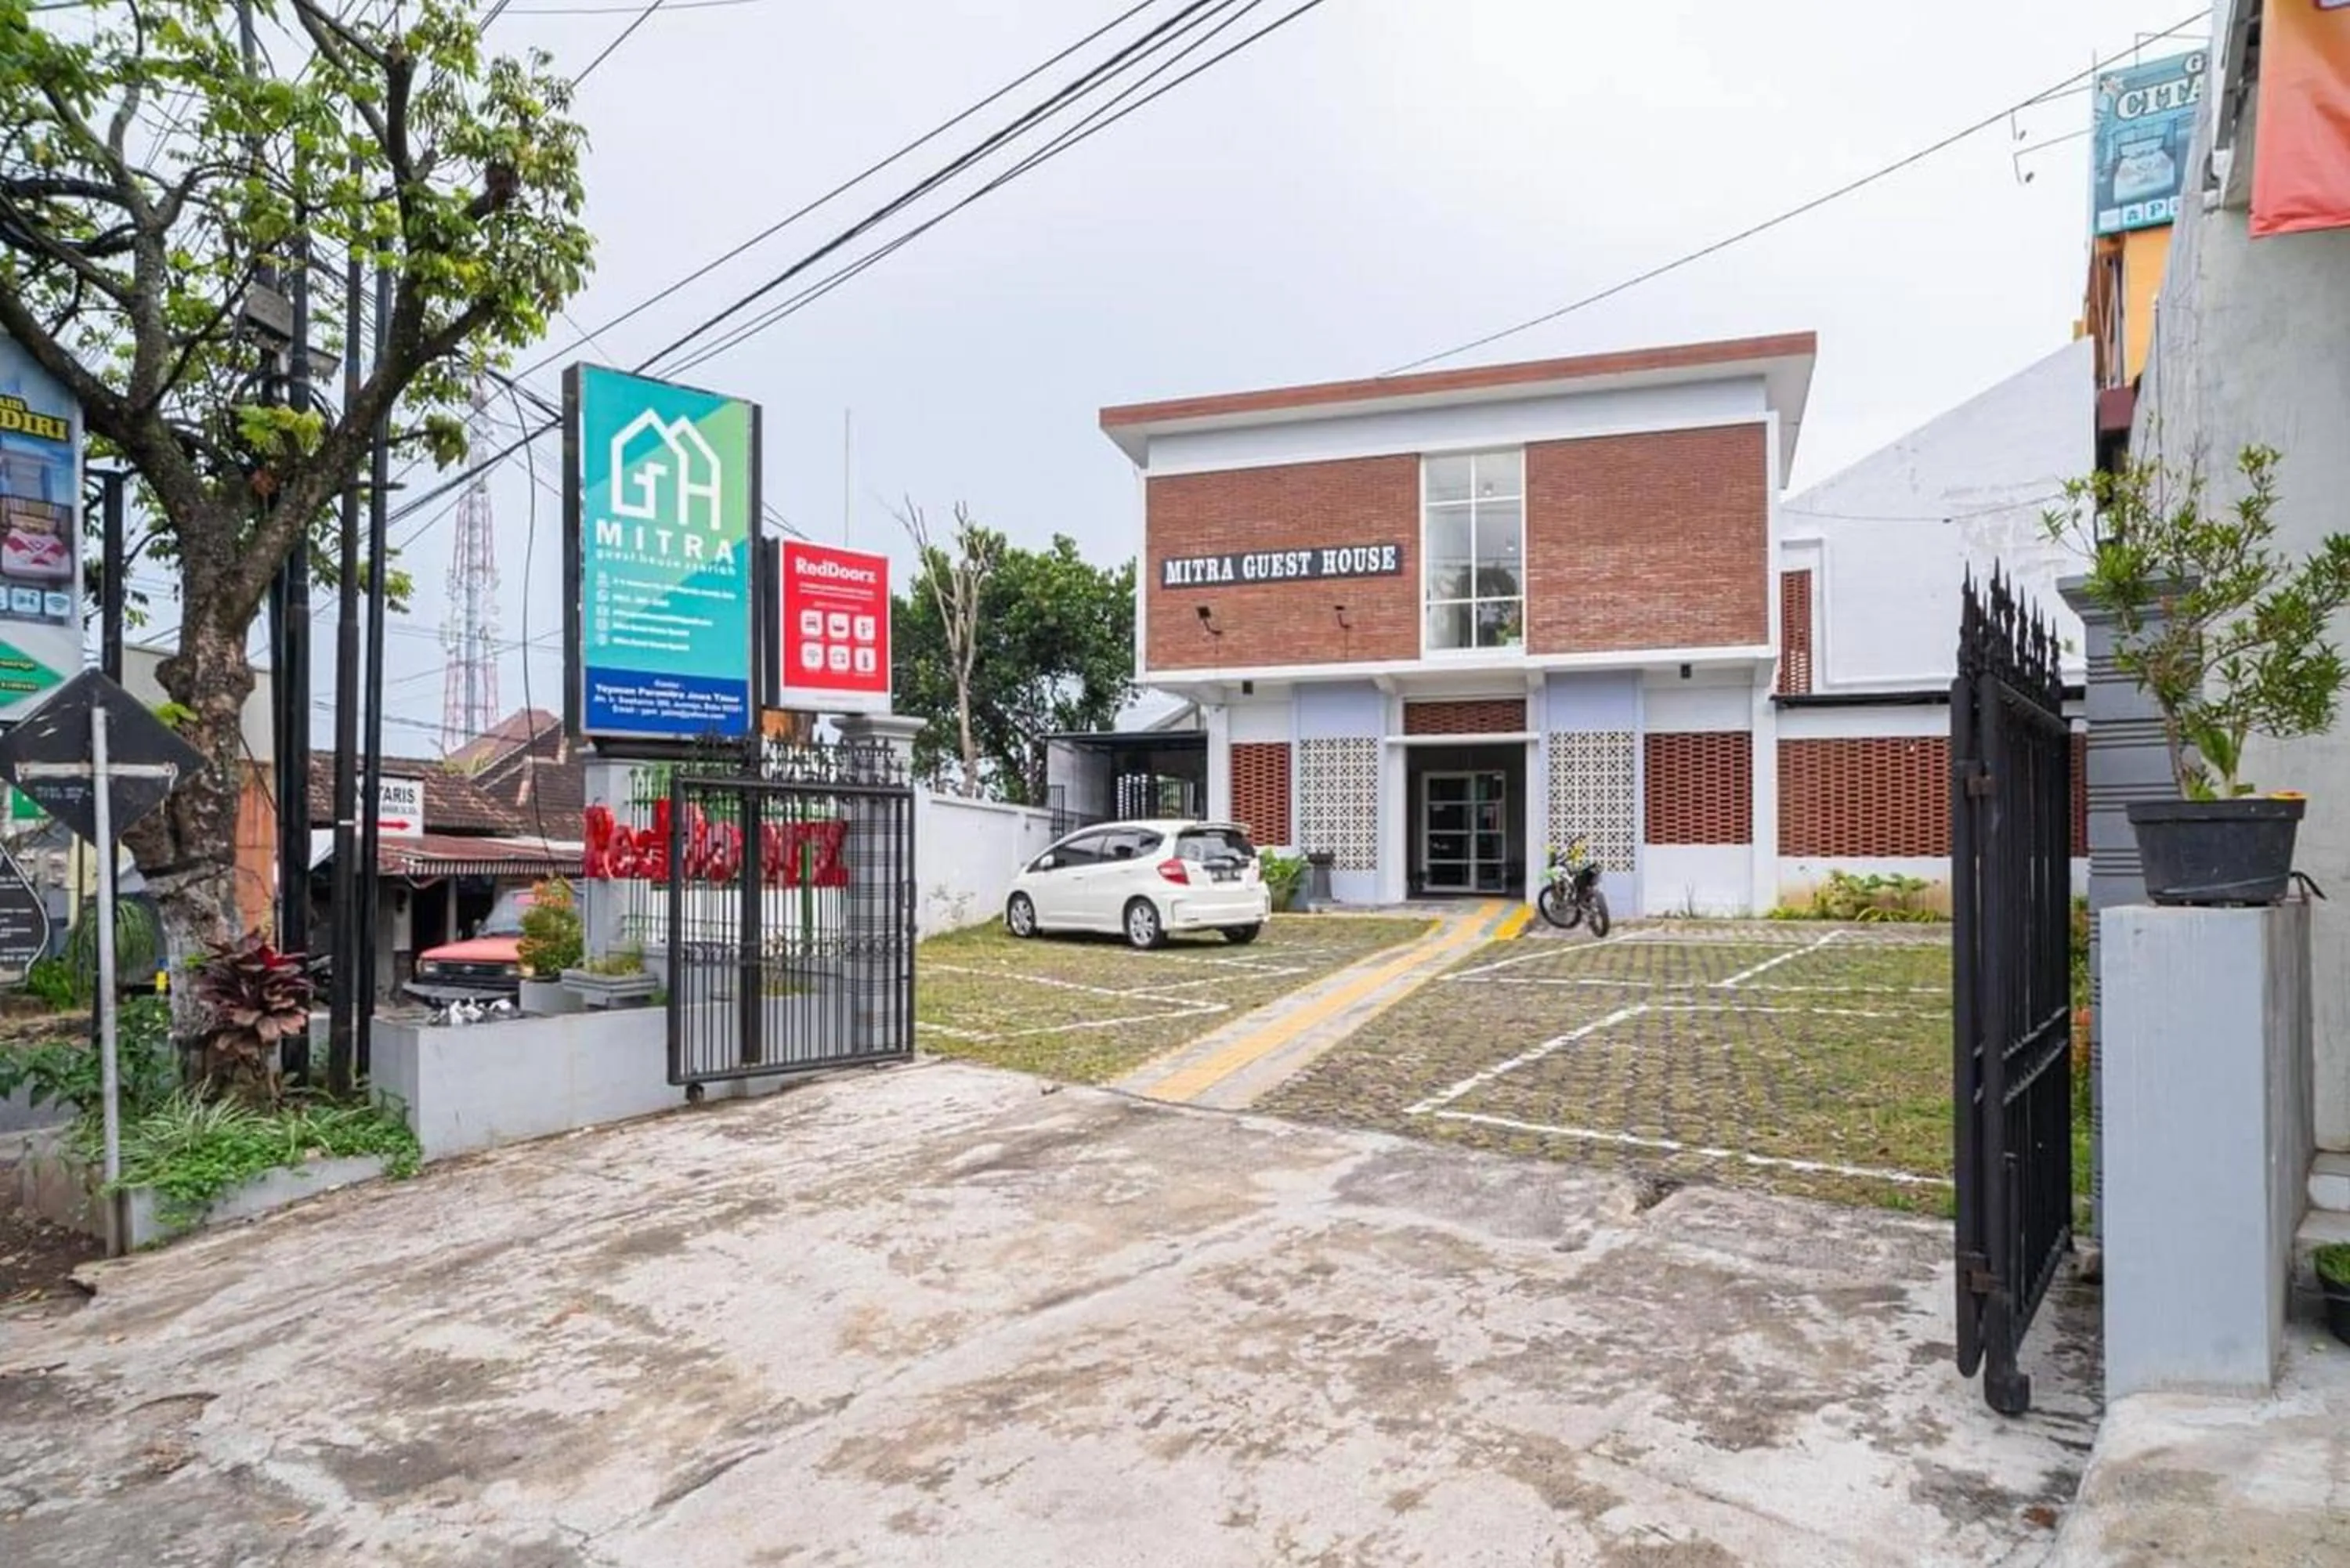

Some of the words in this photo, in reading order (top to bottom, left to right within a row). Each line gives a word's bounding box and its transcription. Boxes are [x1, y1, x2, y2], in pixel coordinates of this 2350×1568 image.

[595, 518, 735, 565] MITRA
[795, 555, 877, 583] RedDoorz
[1165, 557, 1234, 584] MITRA
[1242, 551, 1312, 579] GUEST
[1321, 546, 1396, 575] HOUSE
